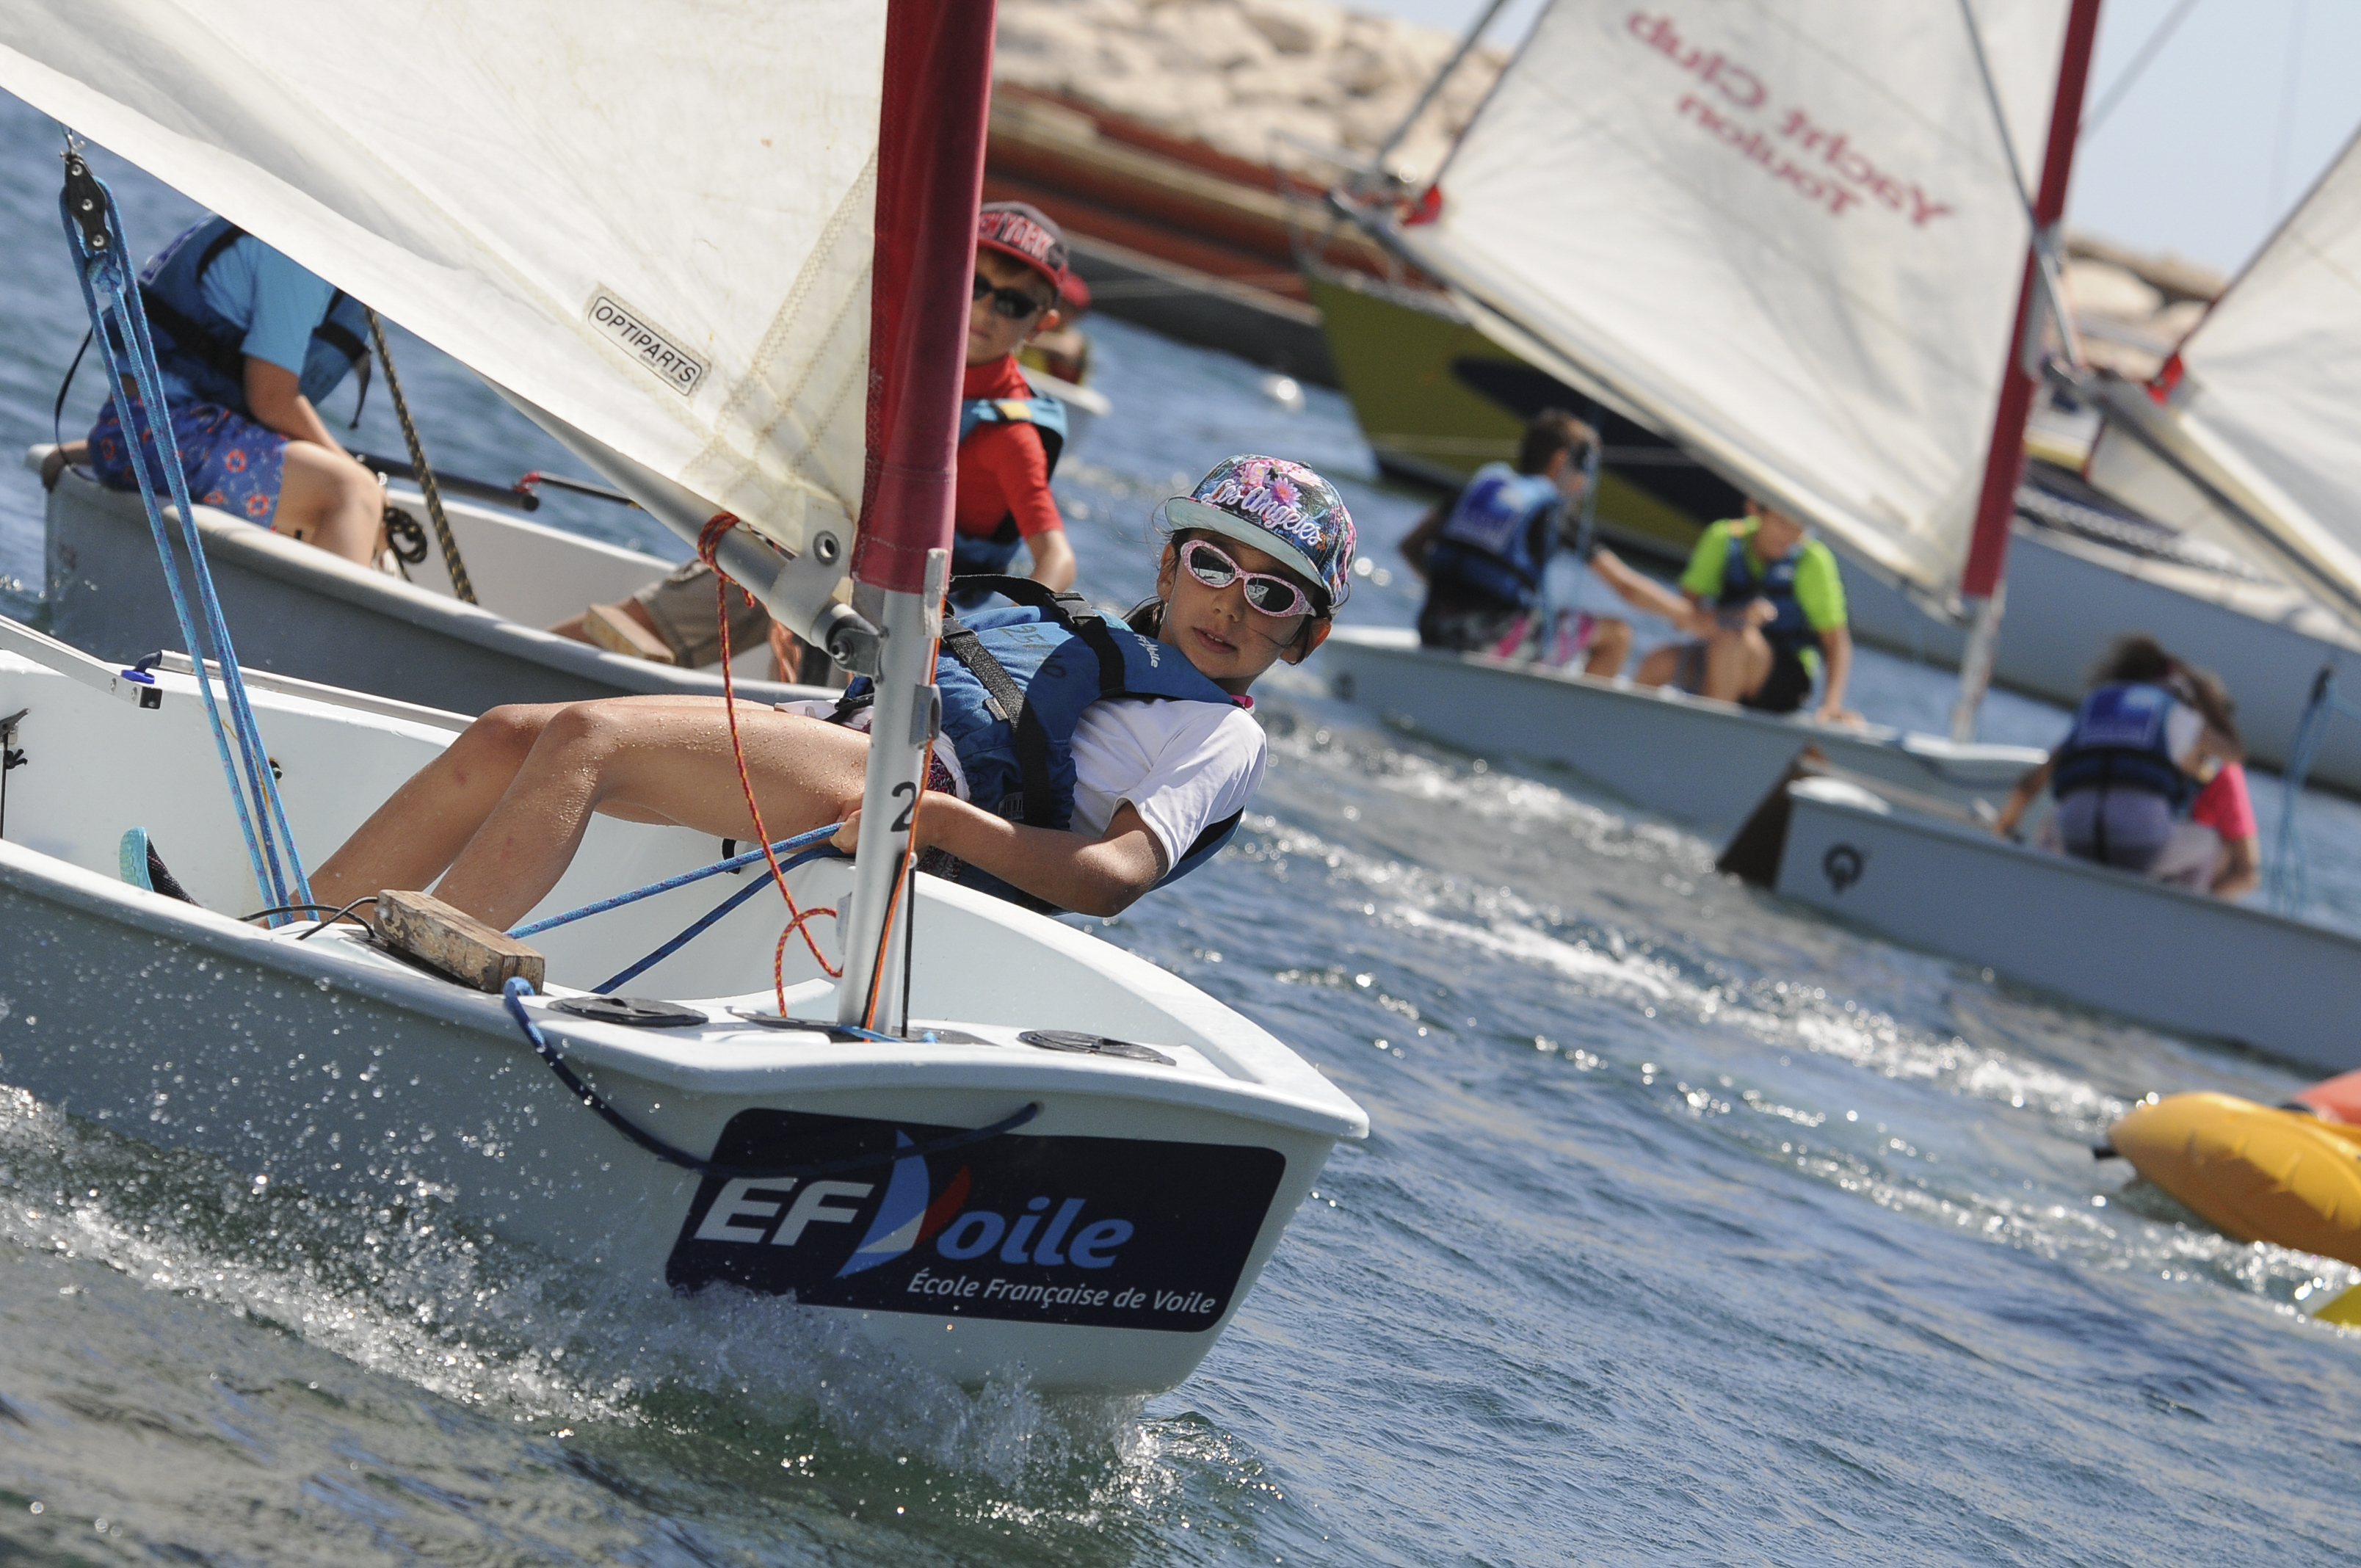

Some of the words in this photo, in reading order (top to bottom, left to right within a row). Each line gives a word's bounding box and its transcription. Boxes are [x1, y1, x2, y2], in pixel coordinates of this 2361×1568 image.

[595, 306, 697, 382] OPTIPARTS
[1200, 479, 1244, 504] Los
[1241, 485, 1322, 546] Angeles
[891, 781, 917, 832] 2
[907, 1267, 980, 1298] École
[983, 1278, 1109, 1310] Française
[1113, 1288, 1147, 1309] de
[1153, 1290, 1216, 1314] Voile
